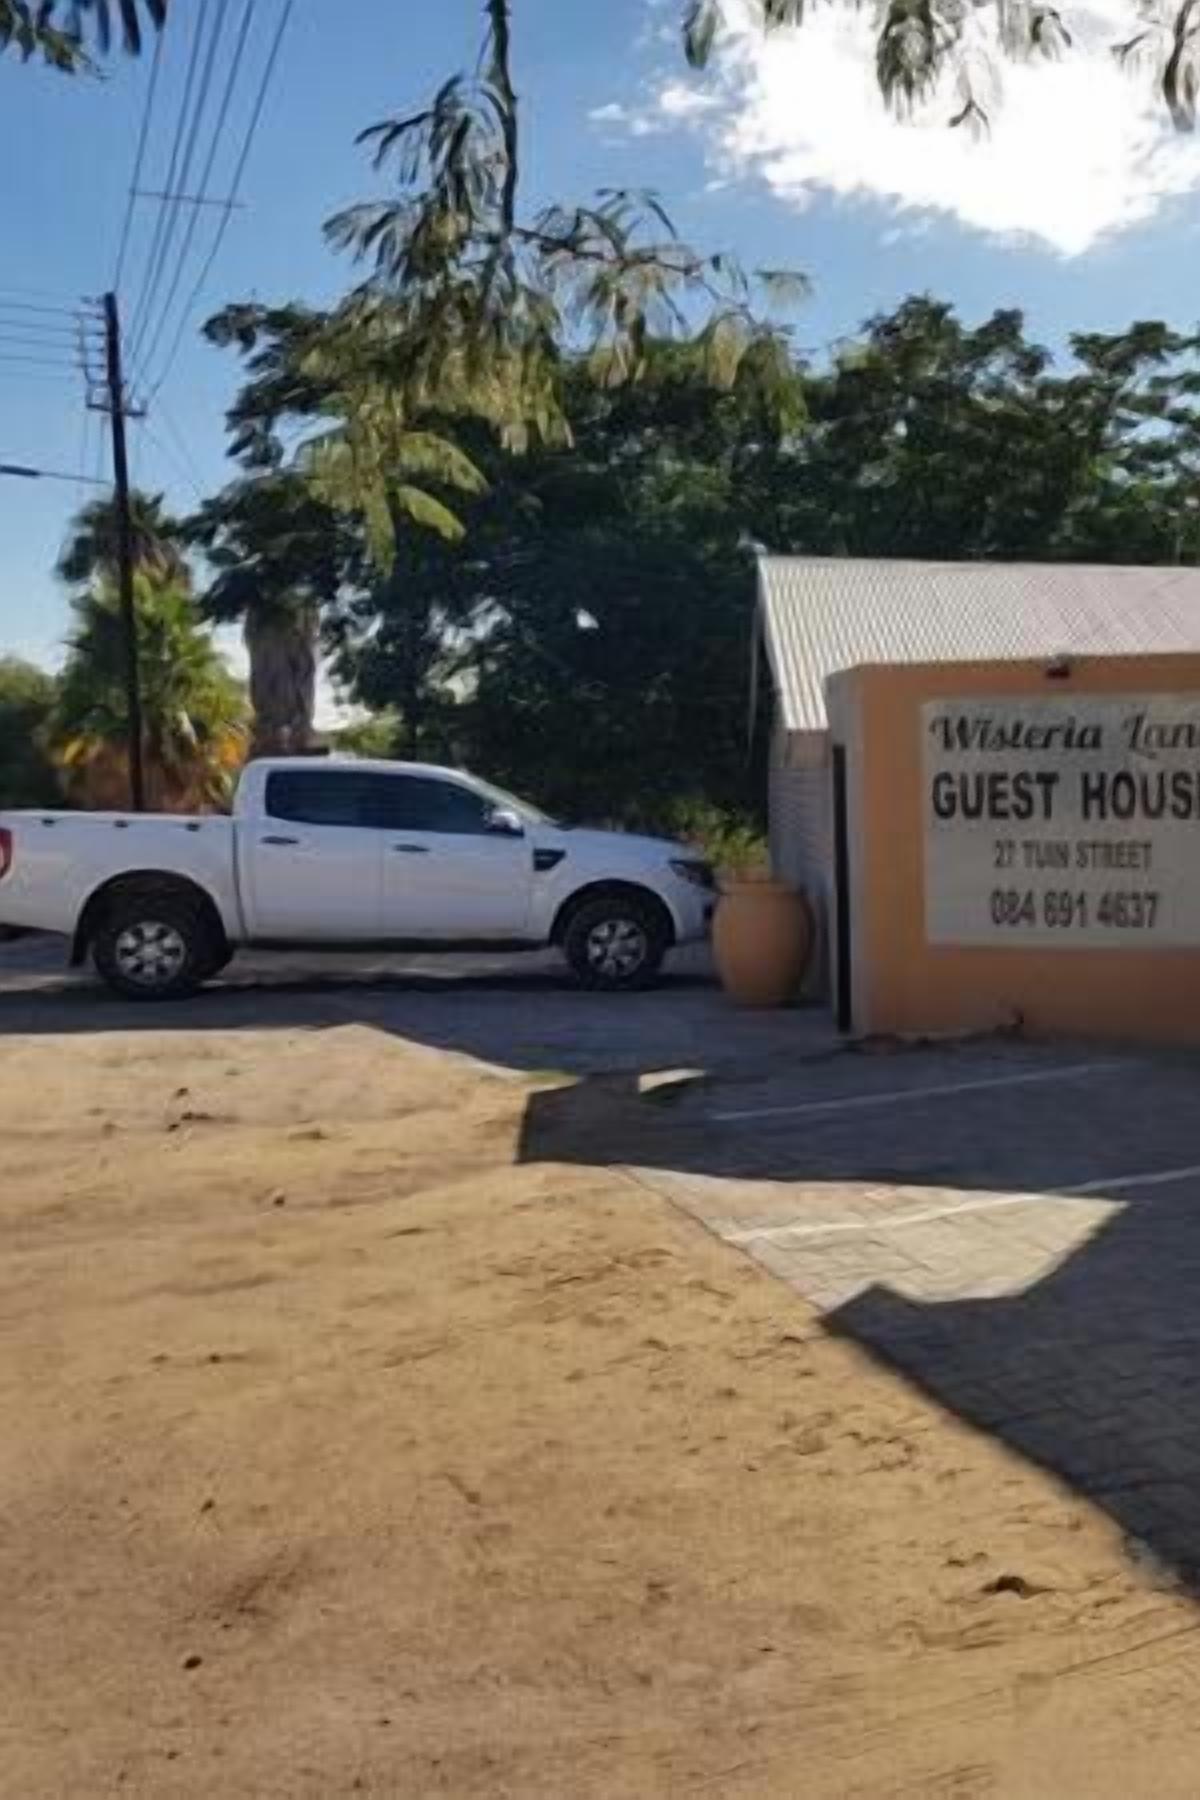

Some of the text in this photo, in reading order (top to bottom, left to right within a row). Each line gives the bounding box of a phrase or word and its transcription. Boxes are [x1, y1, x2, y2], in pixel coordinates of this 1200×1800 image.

[930, 715, 1103, 752] Wisteria
[932, 771, 1060, 820] GUEST
[1075, 839, 1153, 869] STREET
